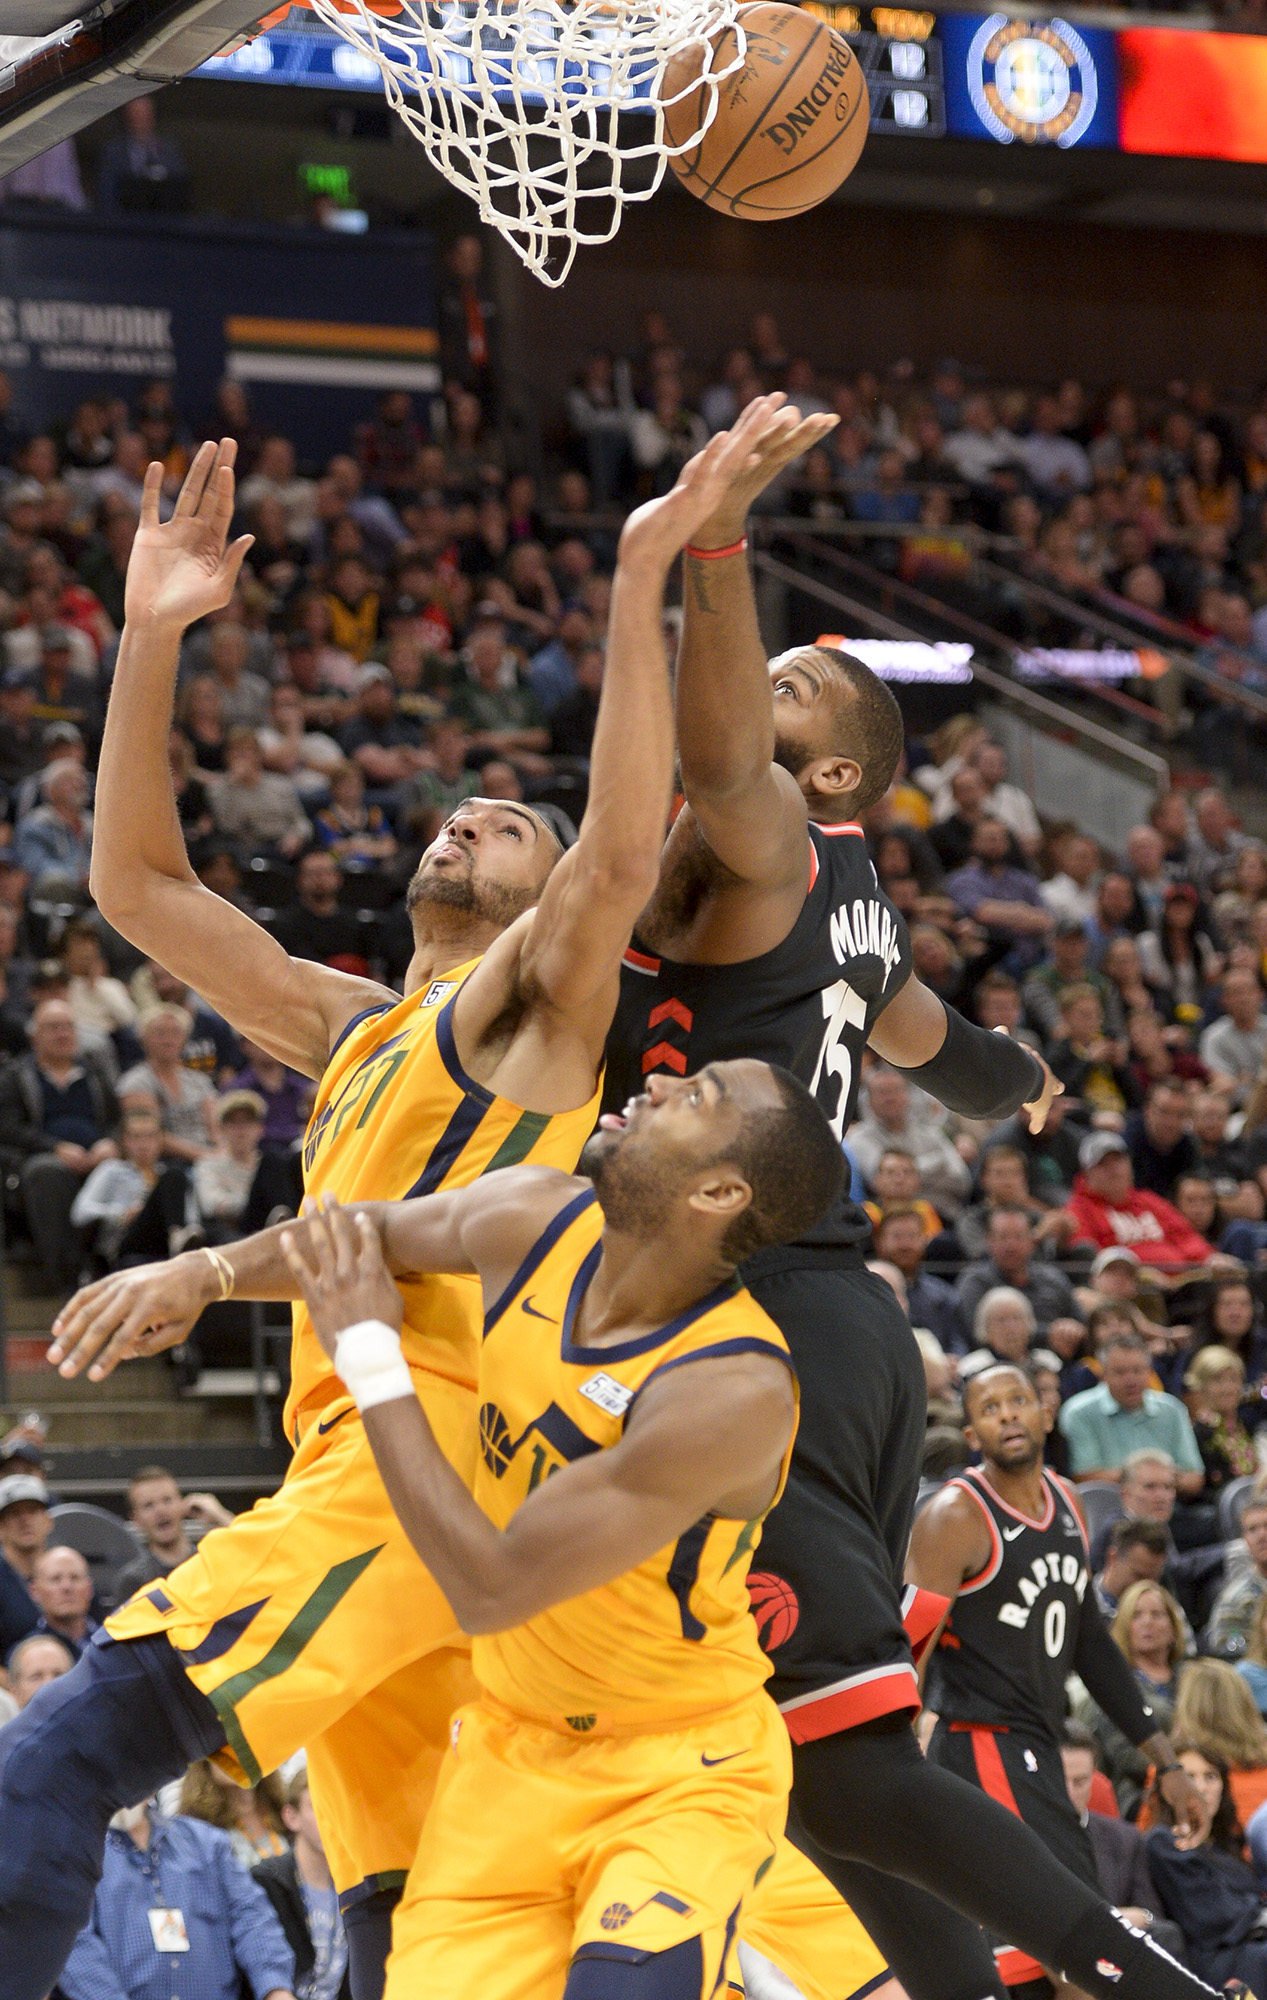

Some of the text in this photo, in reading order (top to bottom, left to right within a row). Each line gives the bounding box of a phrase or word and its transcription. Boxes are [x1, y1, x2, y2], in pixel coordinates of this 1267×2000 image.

[767, 30, 852, 155] SPALDING
[426, 984, 444, 1004] 5
[526, 1443, 561, 1497] 1
[1044, 1600, 1066, 1658] 0
